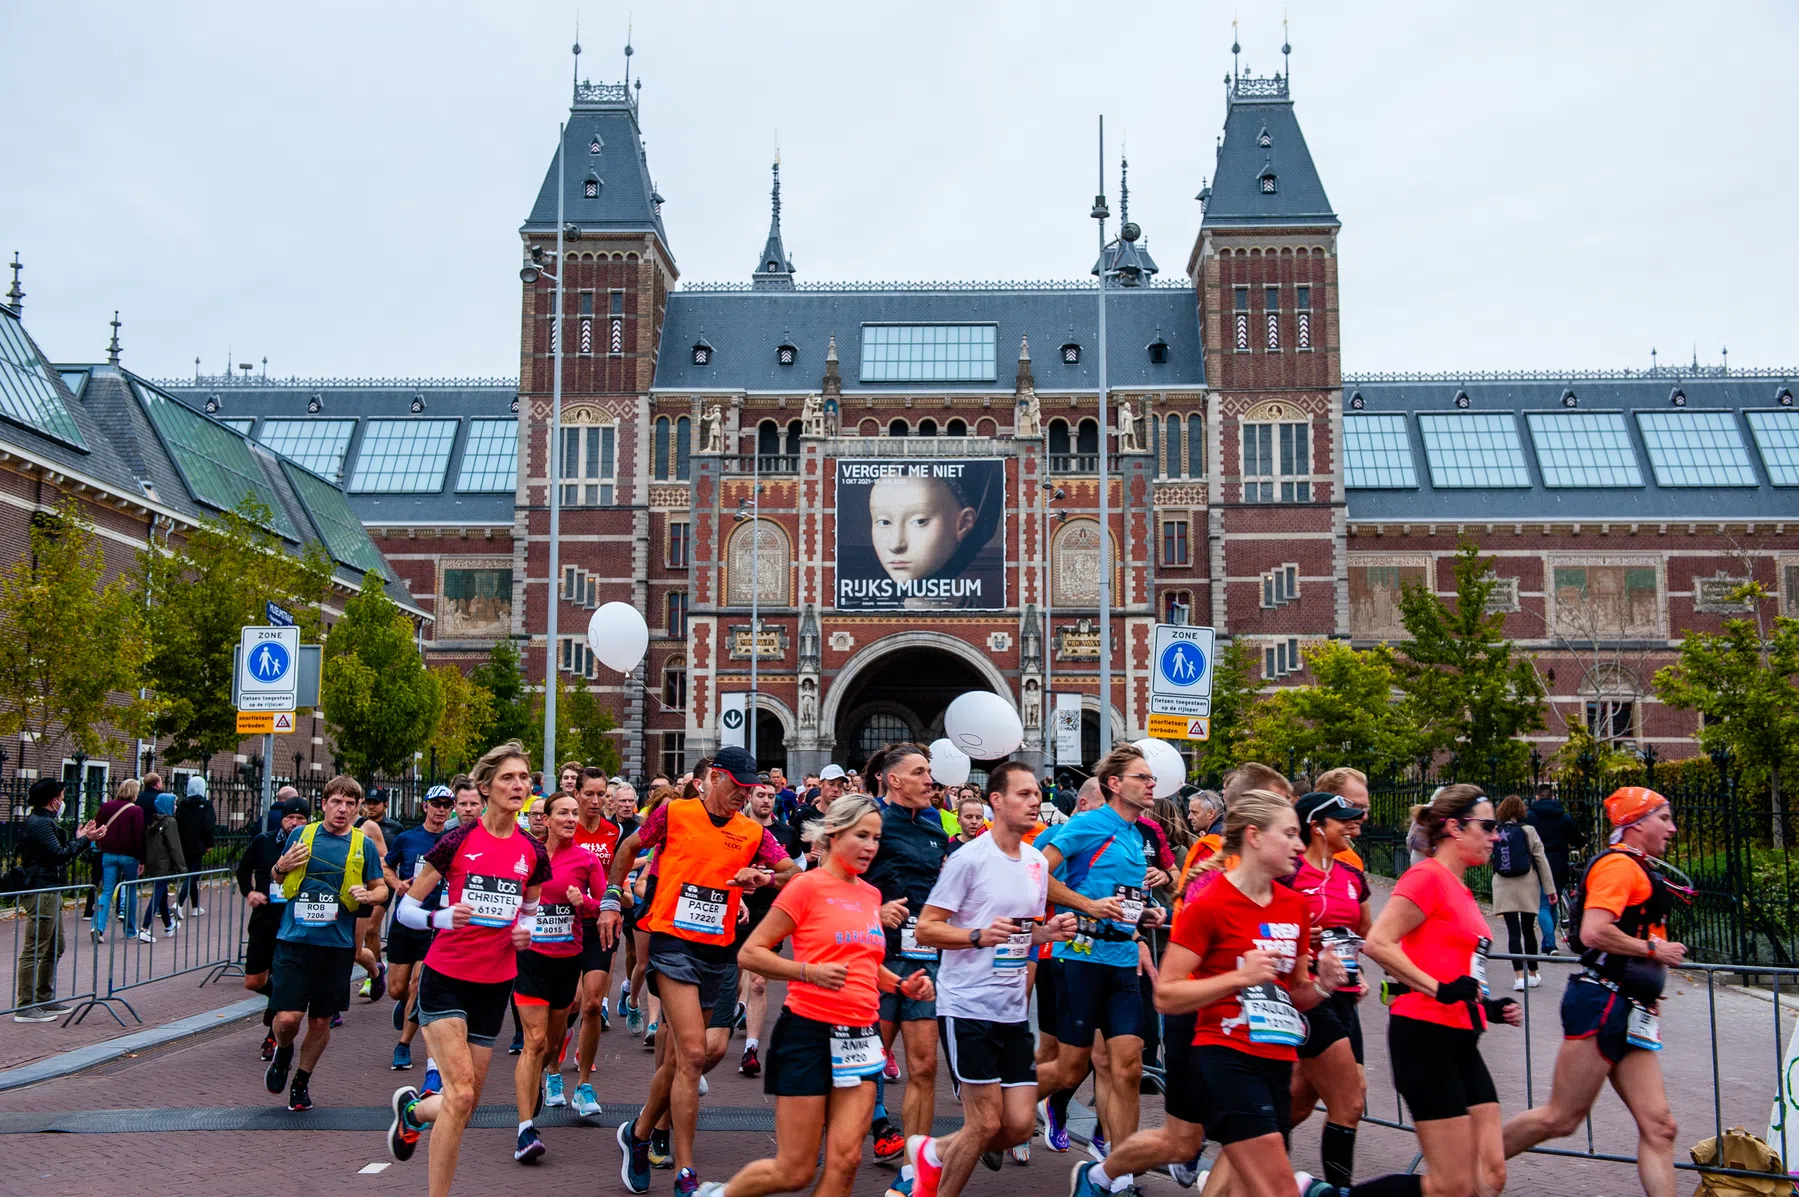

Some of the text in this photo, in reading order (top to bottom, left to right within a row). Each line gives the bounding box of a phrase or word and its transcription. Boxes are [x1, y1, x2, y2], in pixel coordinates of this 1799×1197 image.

[842, 464, 965, 478] VERGEET ME NIET
[840, 578, 982, 597] RIJKS MUSEUM
[1172, 631, 1198, 640] ZONE
[498, 878, 517, 894] tcs
[320, 892, 334, 902] tcs
[468, 892, 517, 906] CHRISTEL
[710, 890, 724, 902] tcs
[478, 906, 503, 916] 6192
[556, 904, 570, 914] tcs
[688, 900, 720, 913] PACER
[536, 916, 569, 925] SABINE
[690, 912, 716, 924] 17220
